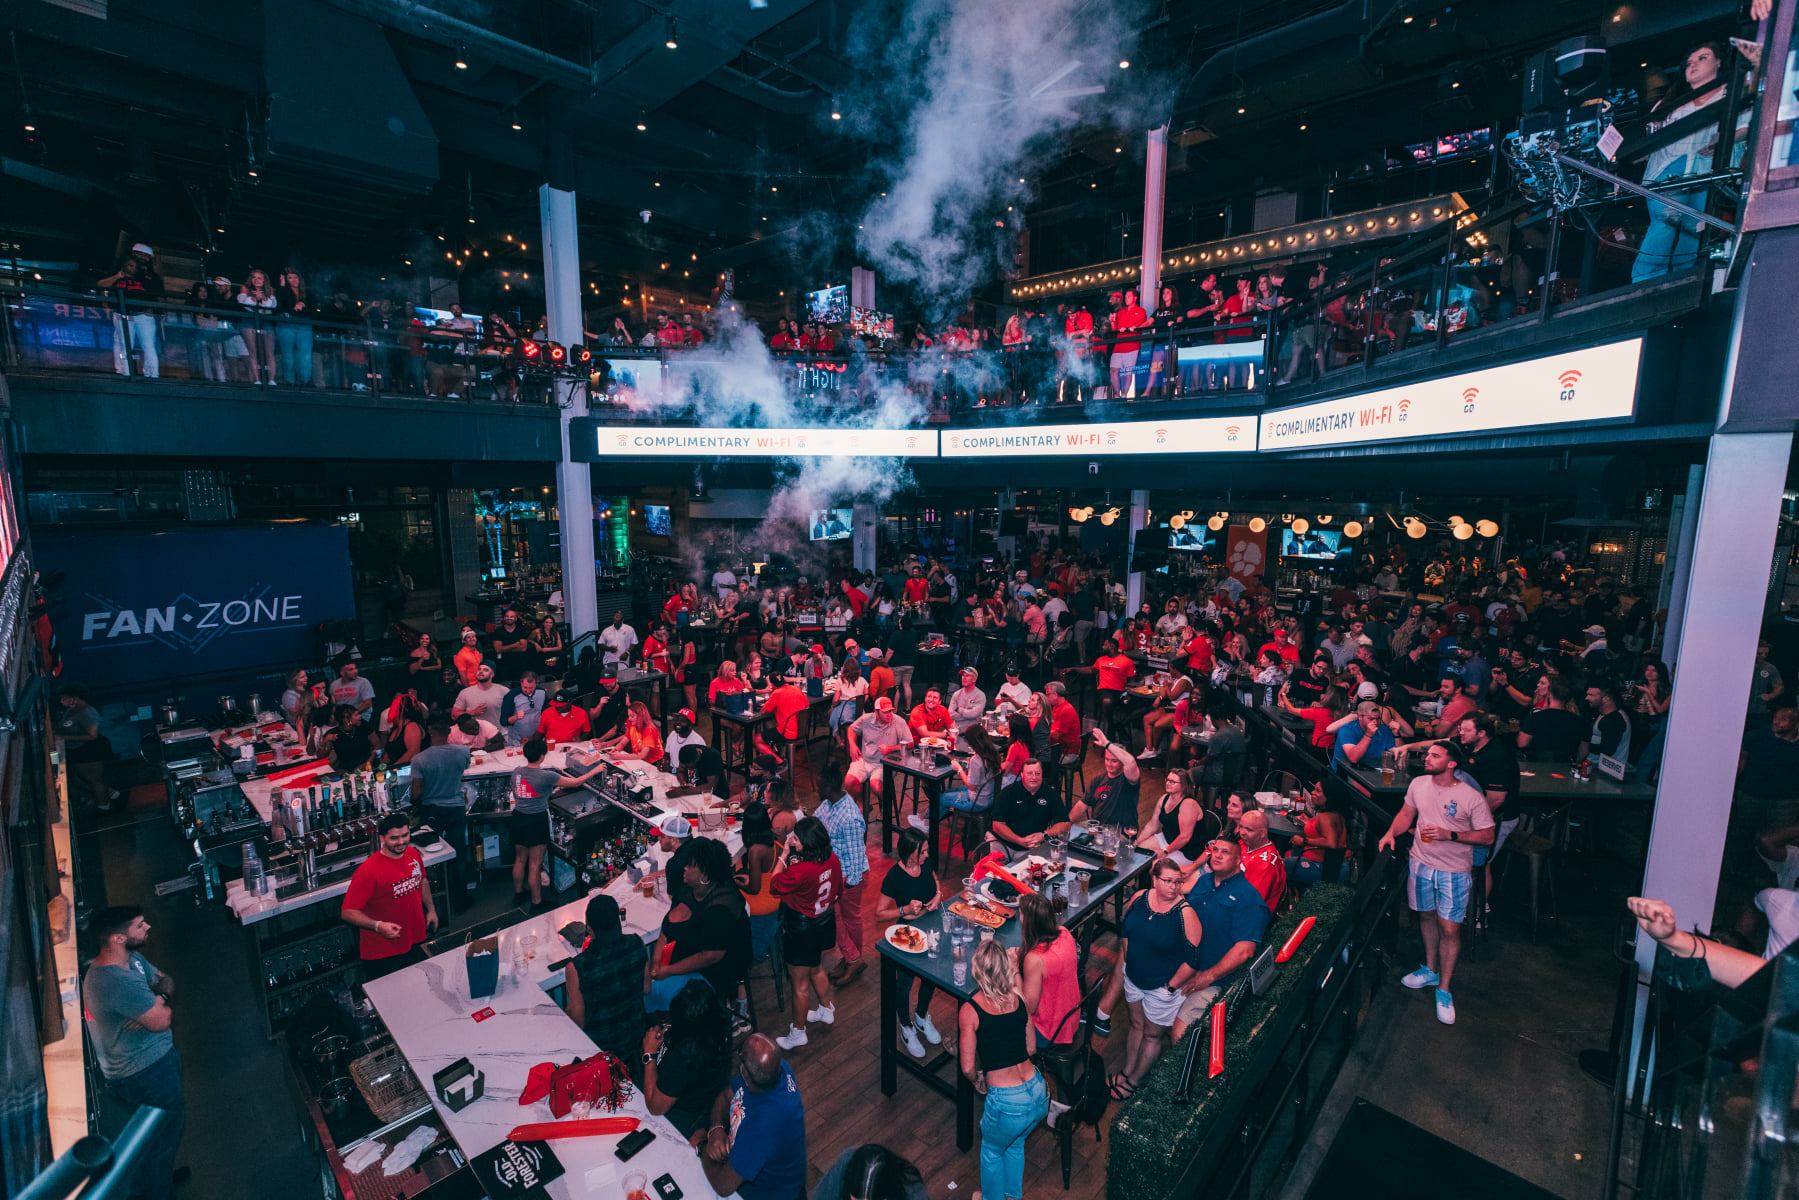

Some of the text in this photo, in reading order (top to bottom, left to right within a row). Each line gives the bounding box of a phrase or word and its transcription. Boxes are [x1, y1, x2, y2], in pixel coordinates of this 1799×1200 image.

[1560, 389, 1575, 401] GO
[1276, 405, 1392, 437] COMPLIMENTARY WI-FI
[634, 436, 791, 448] COMPLIMENTARY WI-FI
[963, 434, 1100, 448] COMPLIMENTARY WI-FI
[82, 595, 302, 641] FAN ZONE
[1259, 851, 1278, 866] 47
[814, 880, 832, 916] 2
[504, 1141, 539, 1189] FORESTER
